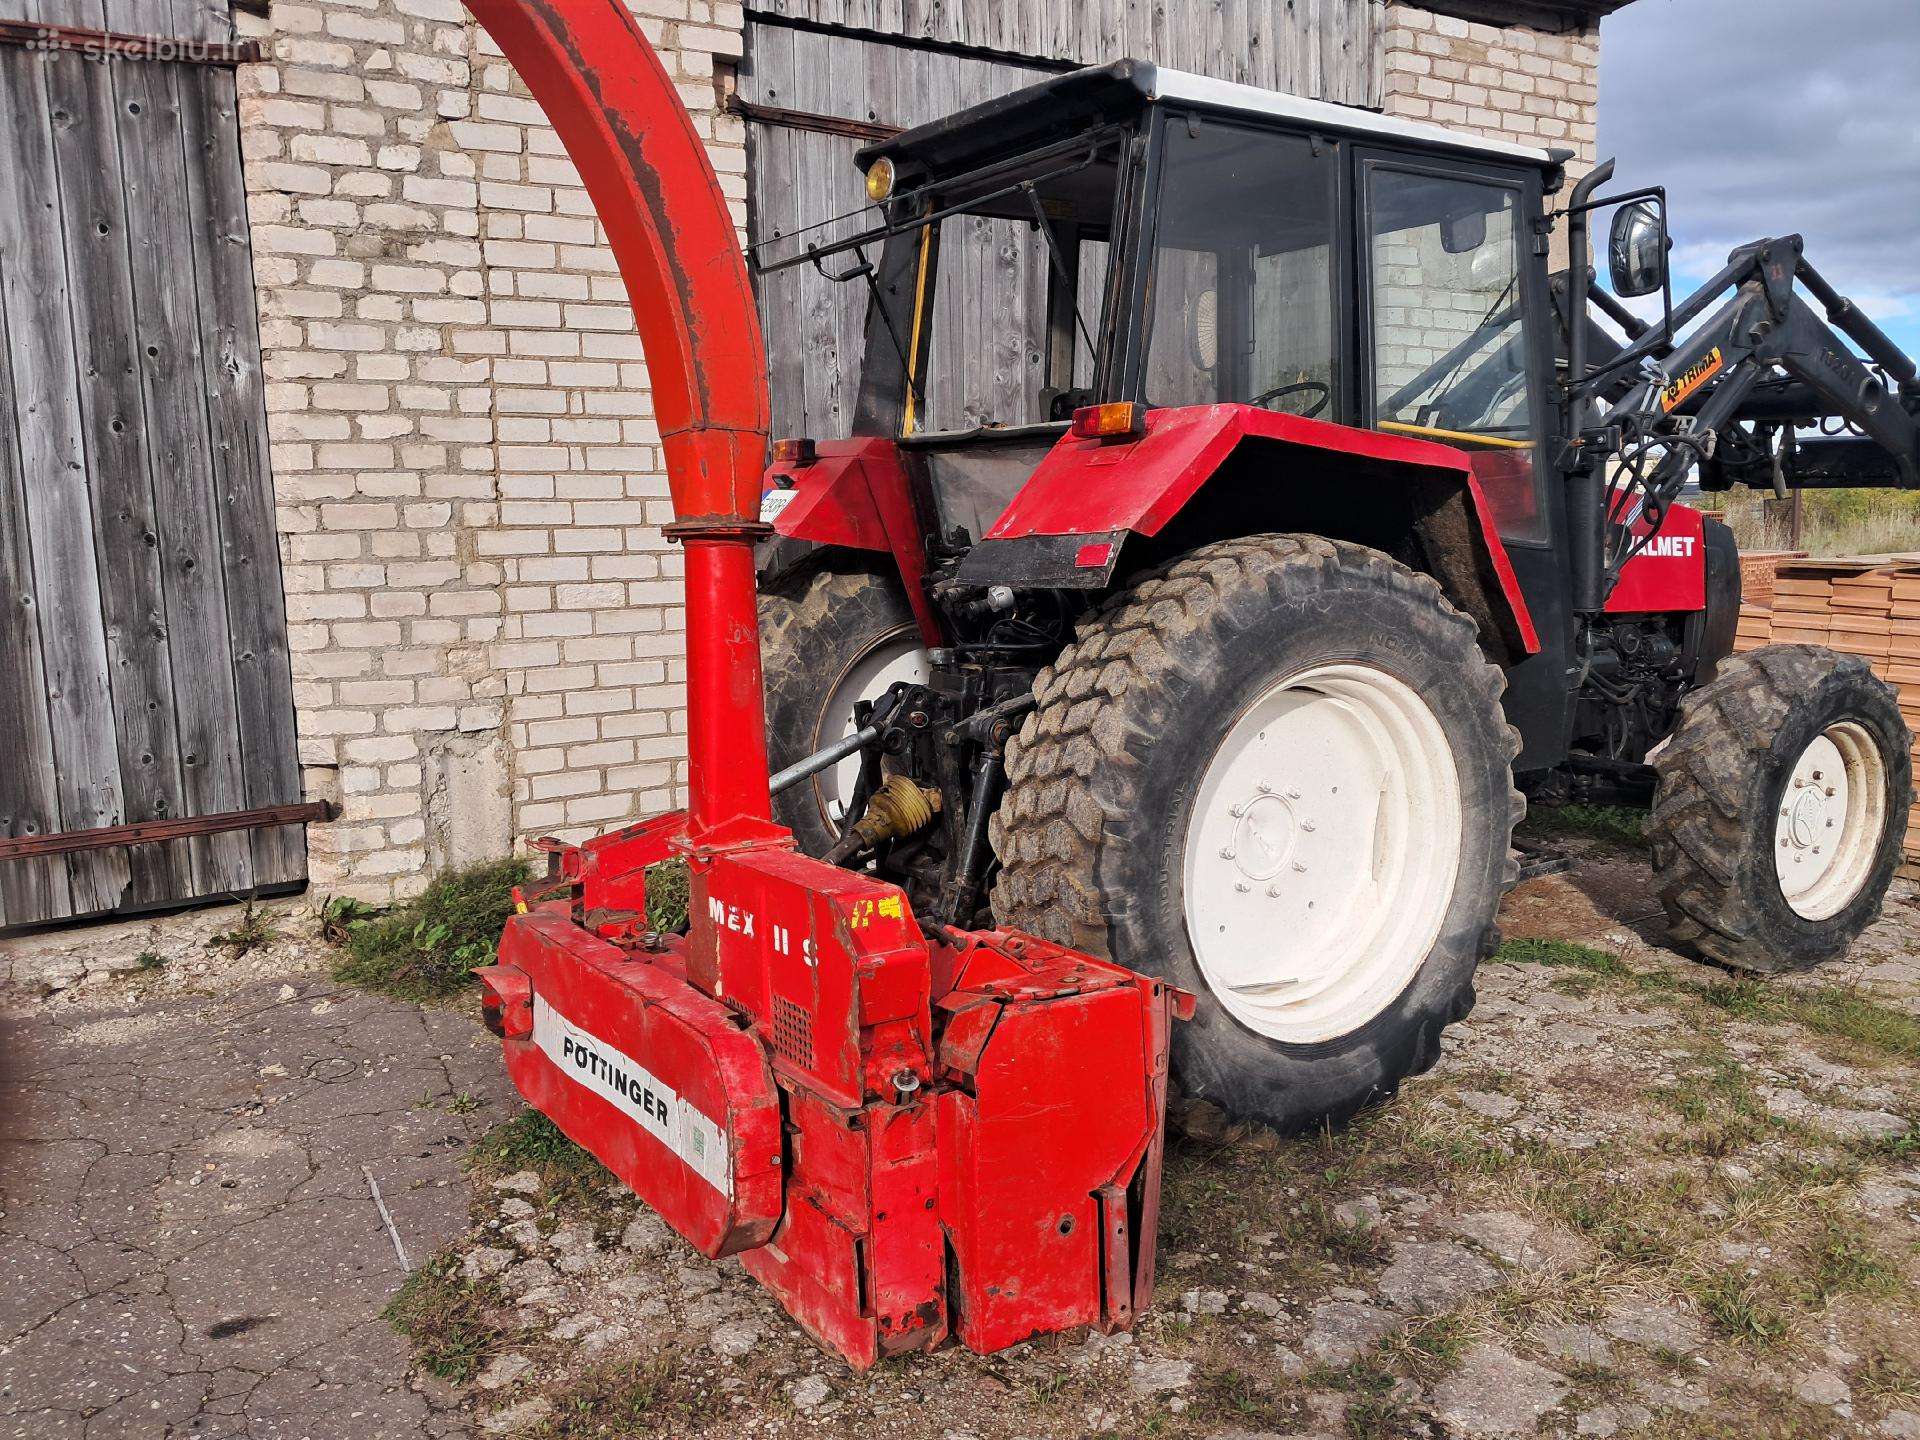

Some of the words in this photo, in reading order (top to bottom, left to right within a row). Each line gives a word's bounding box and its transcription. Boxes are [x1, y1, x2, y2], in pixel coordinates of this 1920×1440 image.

[1676, 350, 1717, 388] TRIMA
[708, 896, 755, 938] MEX
[563, 1036, 668, 1127] PÖTTINGER
